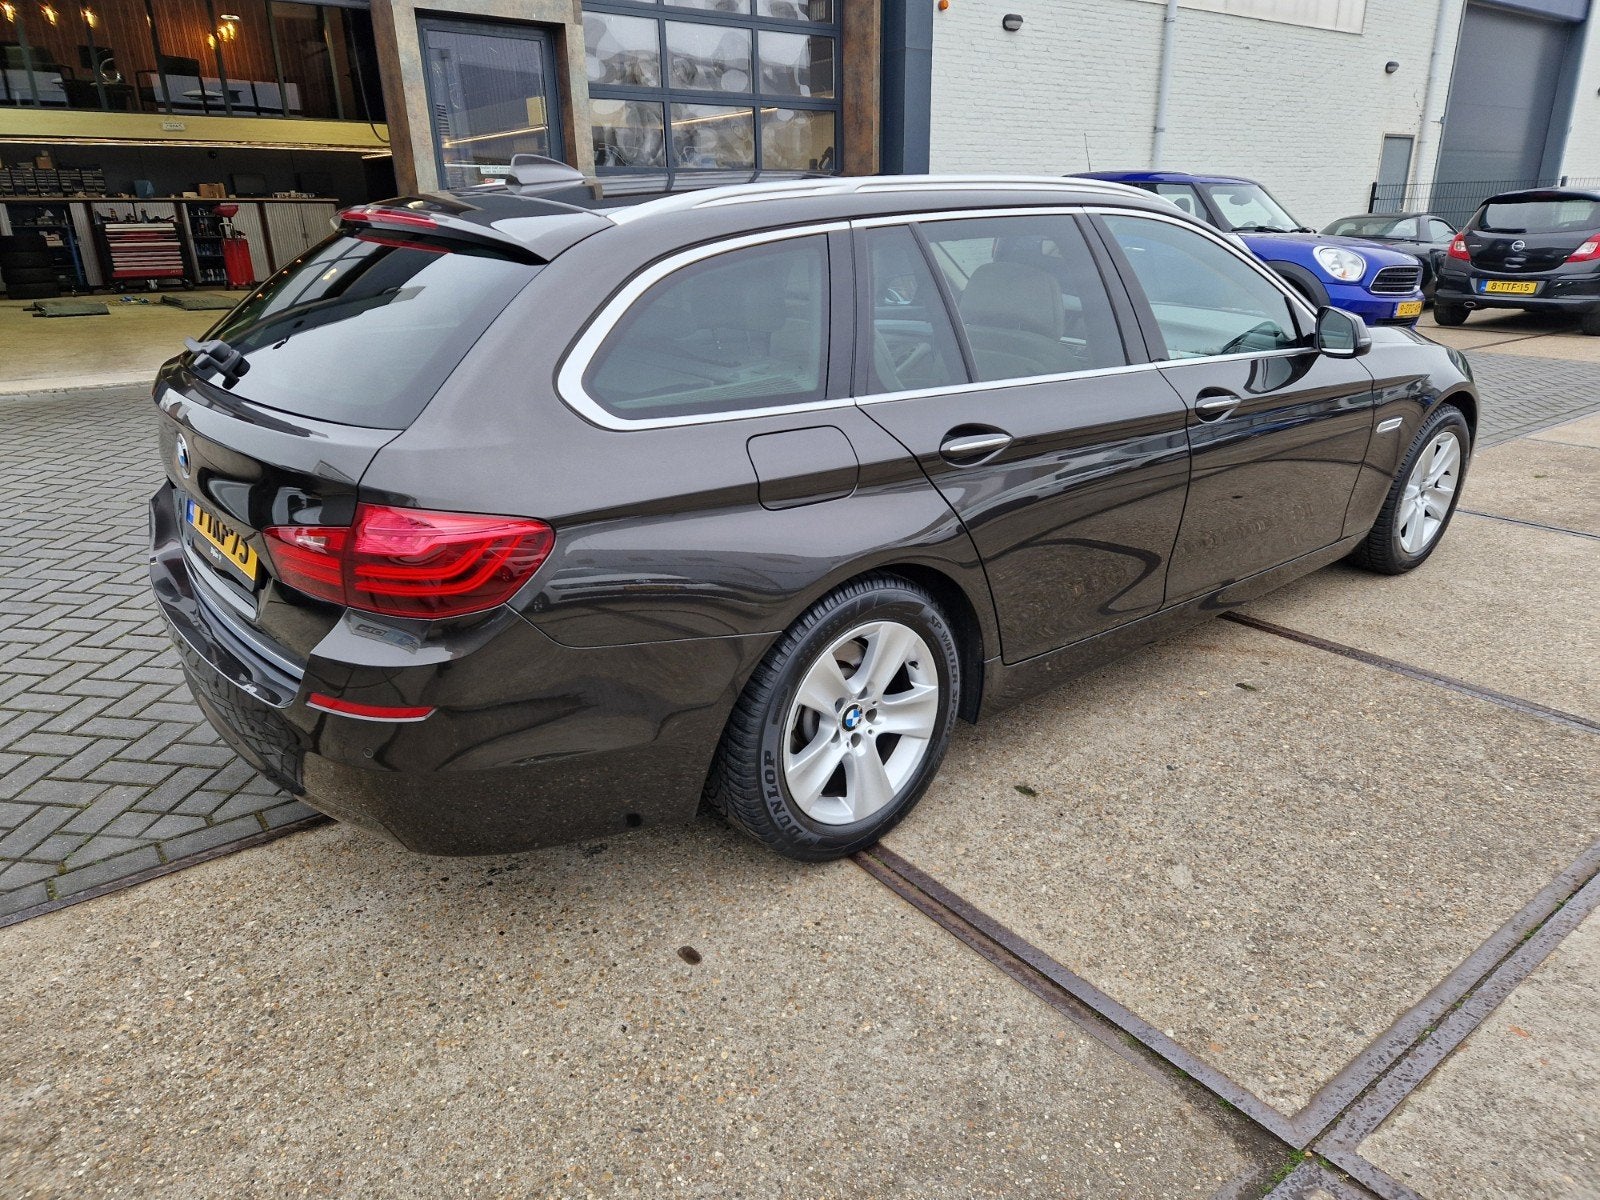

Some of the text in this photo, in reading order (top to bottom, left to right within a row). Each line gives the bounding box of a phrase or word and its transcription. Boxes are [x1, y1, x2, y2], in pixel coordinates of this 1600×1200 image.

[1491, 282, 1530, 292] 8-TTF-15
[930, 614, 943, 631] SP
[940, 630, 959, 685] WINTER
[763, 750, 804, 839] DUNLOP
